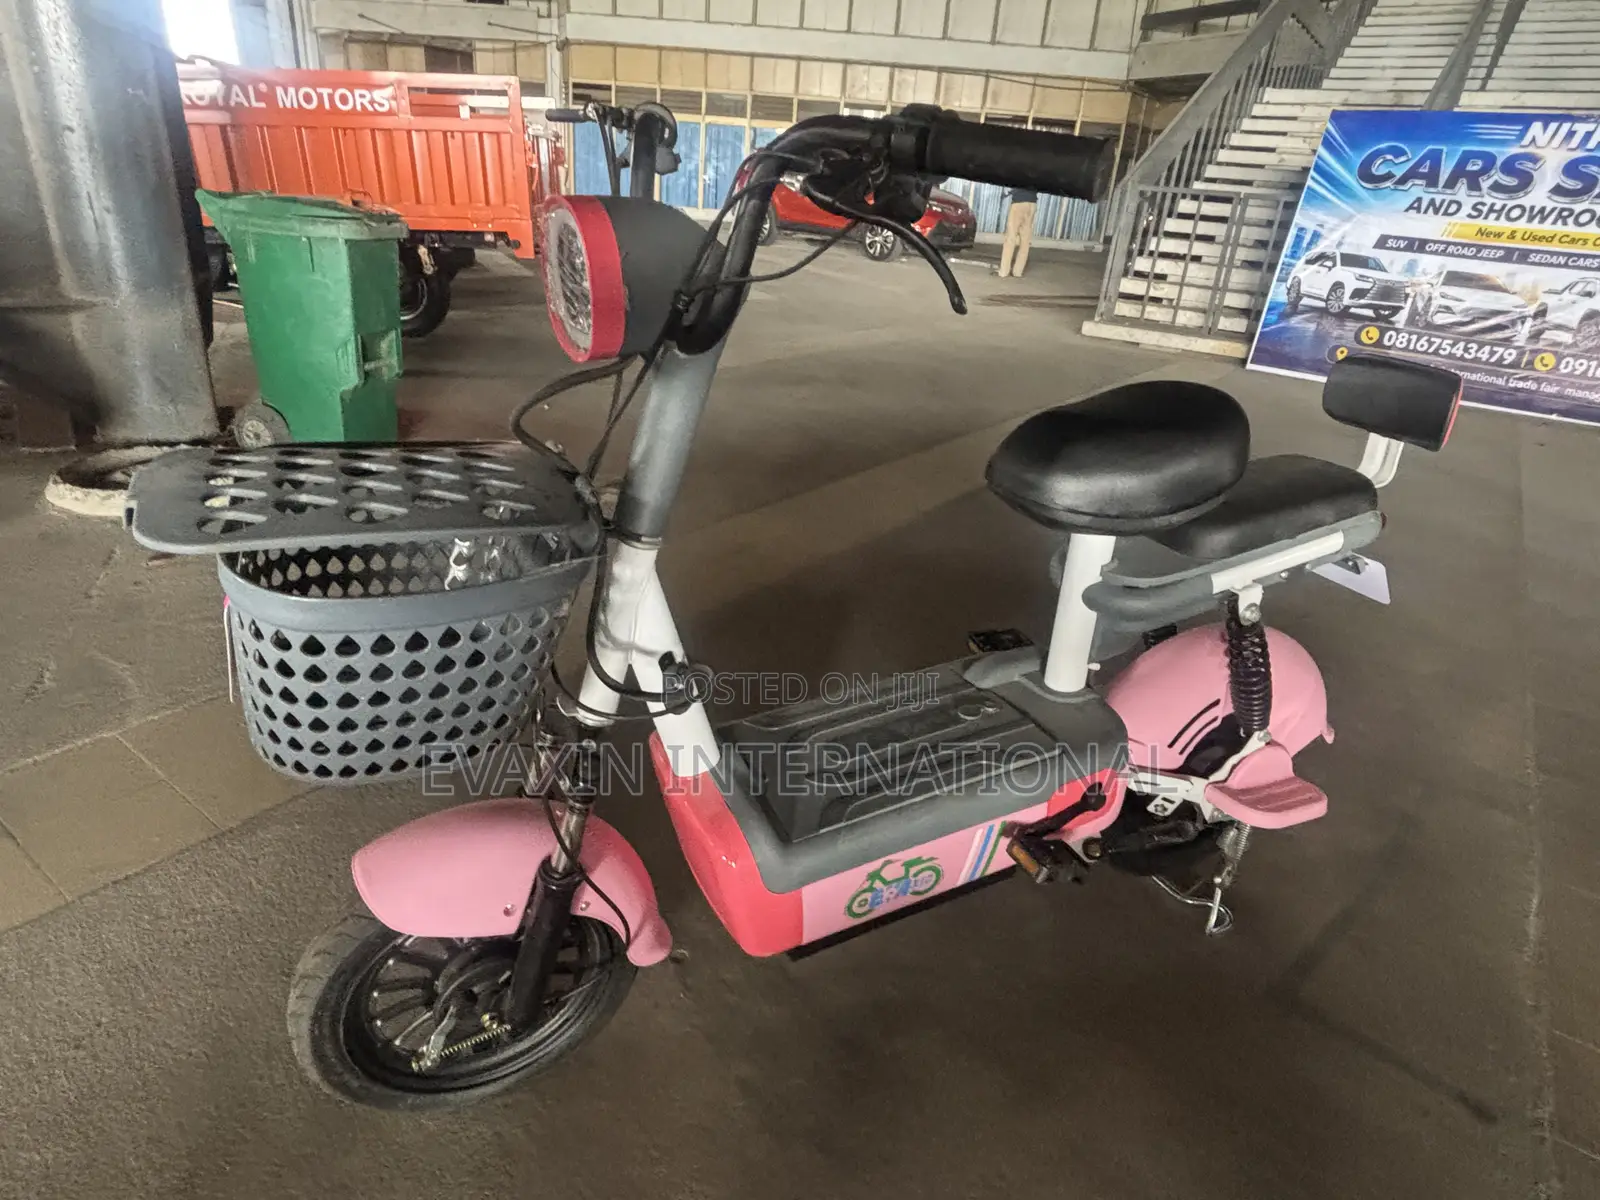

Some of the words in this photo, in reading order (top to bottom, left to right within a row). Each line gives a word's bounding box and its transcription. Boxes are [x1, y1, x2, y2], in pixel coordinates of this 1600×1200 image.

[275, 85, 391, 112] MOTORS
[1519, 121, 1600, 151] NIT
[1356, 142, 1546, 200] CARS
[1547, 153, 1600, 204] S
[1404, 196, 1463, 217] AND
[1466, 201, 1600, 229] SHOWRO
[1474, 226, 1505, 240] New
[1510, 230, 1521, 240] &
[1521, 231, 1558, 244] Used
[1558, 234, 1590, 246] Cars
[1385, 238, 1409, 249] SUV
[1425, 242, 1448, 253] OFF
[1447, 244, 1477, 257] ROAD
[1477, 248, 1505, 259] JEEP
[1527, 252, 1568, 265] SEDAN
[1567, 256, 1600, 268] CARS
[1383, 330, 1518, 365] 08167543479
[1539, 381, 1561, 394] fair
